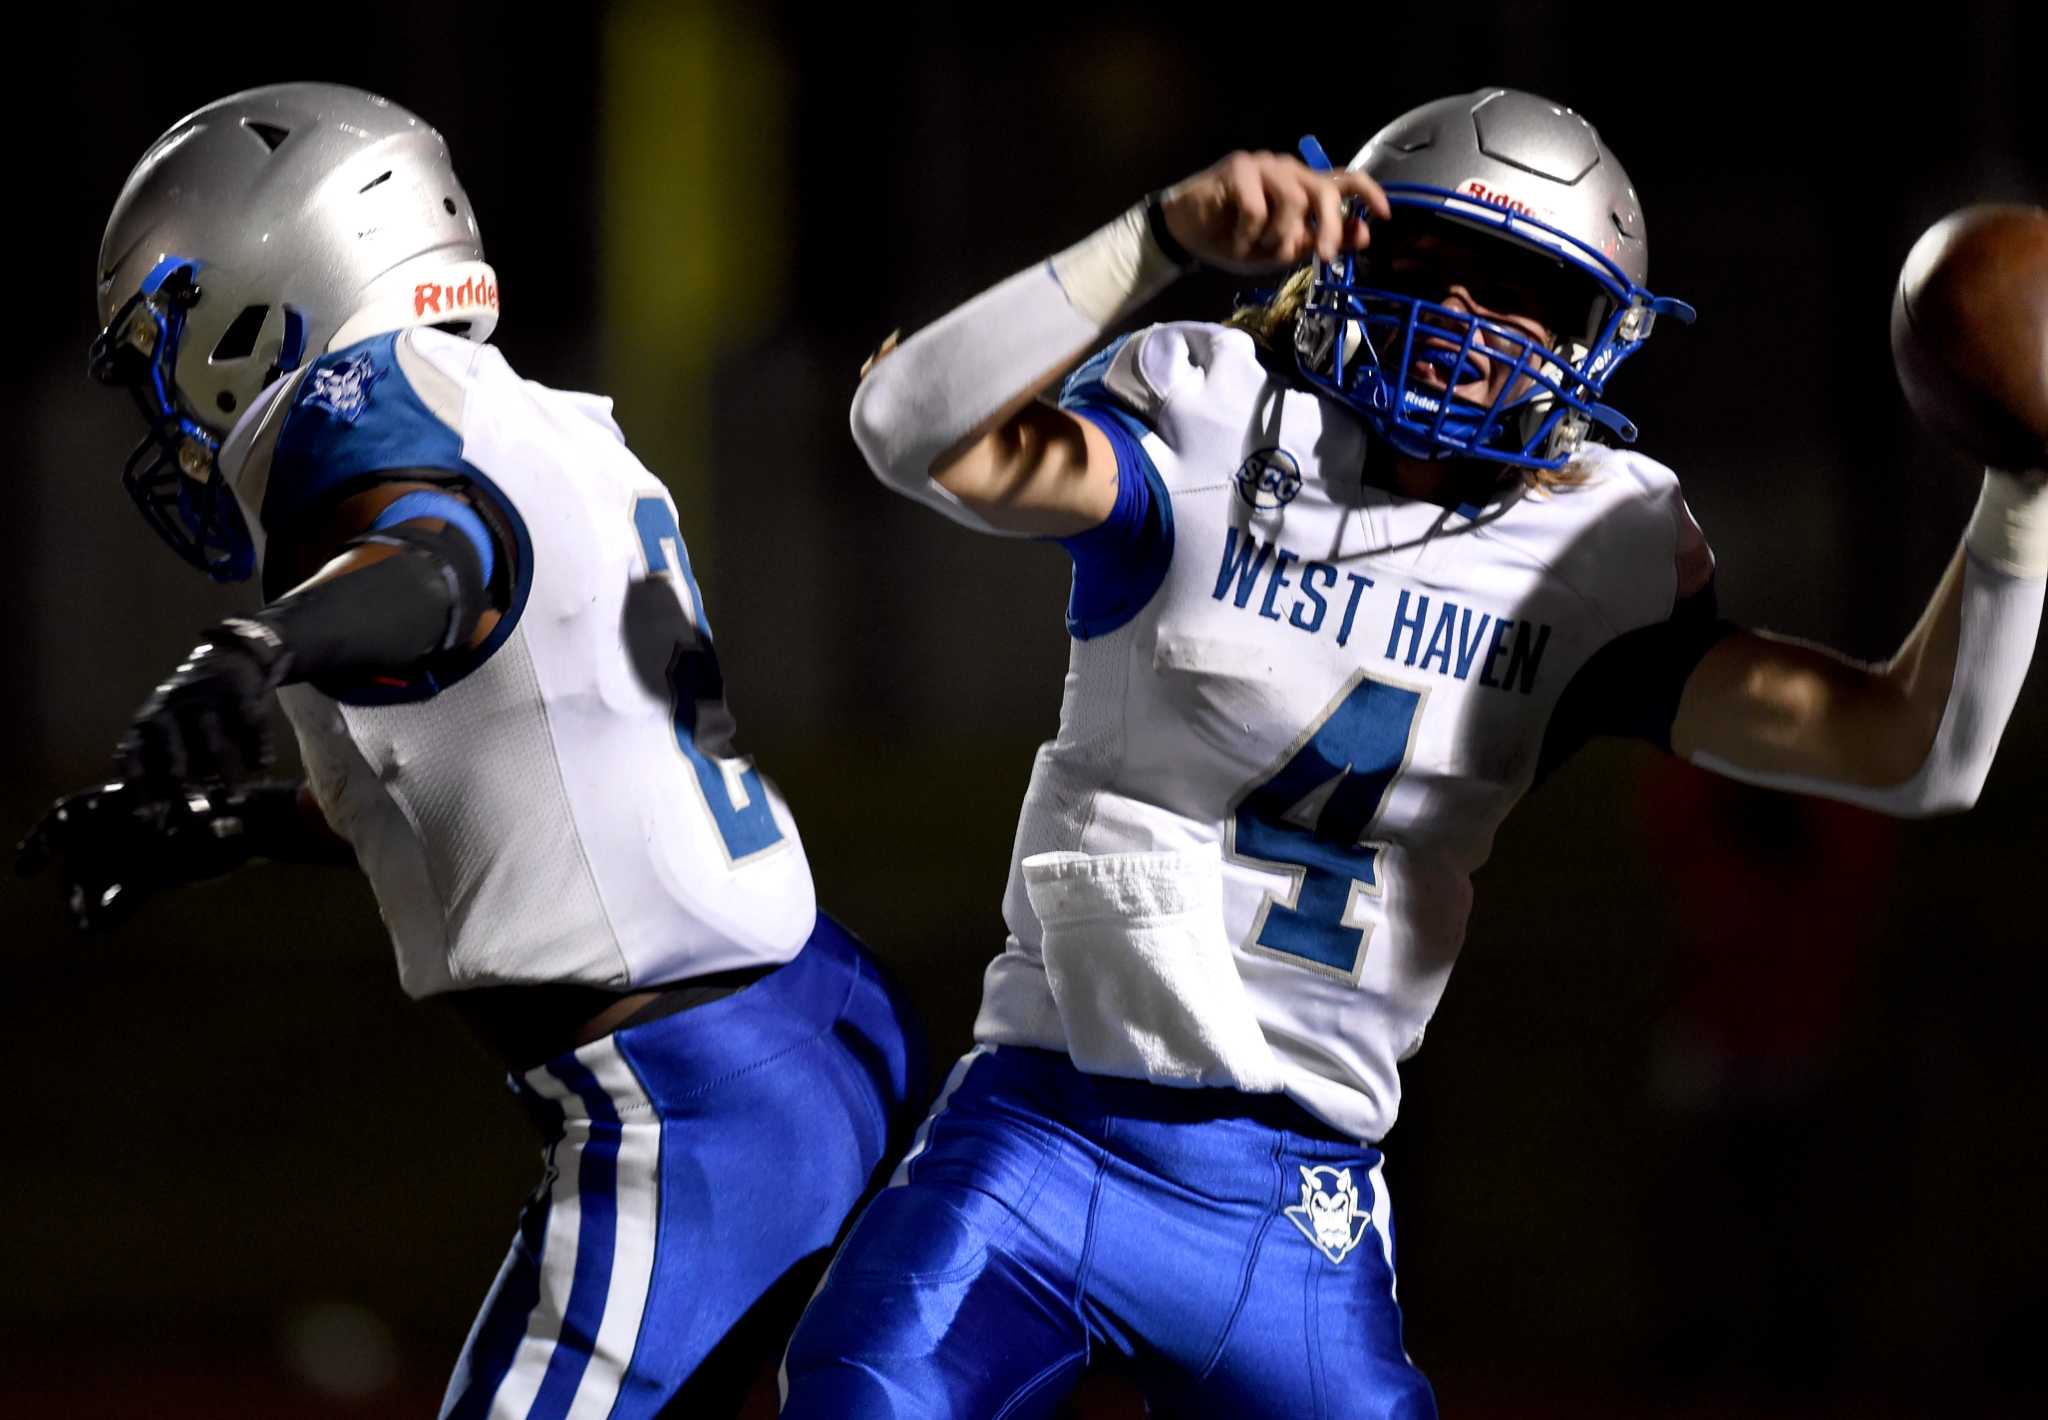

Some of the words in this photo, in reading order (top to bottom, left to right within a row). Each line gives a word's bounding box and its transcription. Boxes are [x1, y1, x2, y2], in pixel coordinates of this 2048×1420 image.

[414, 274, 496, 317] Ridde
[1404, 390, 1440, 413] Ridde
[1213, 527, 1374, 647] WEST
[1385, 590, 1551, 694] HAVEN
[1223, 669, 1430, 985] 4
